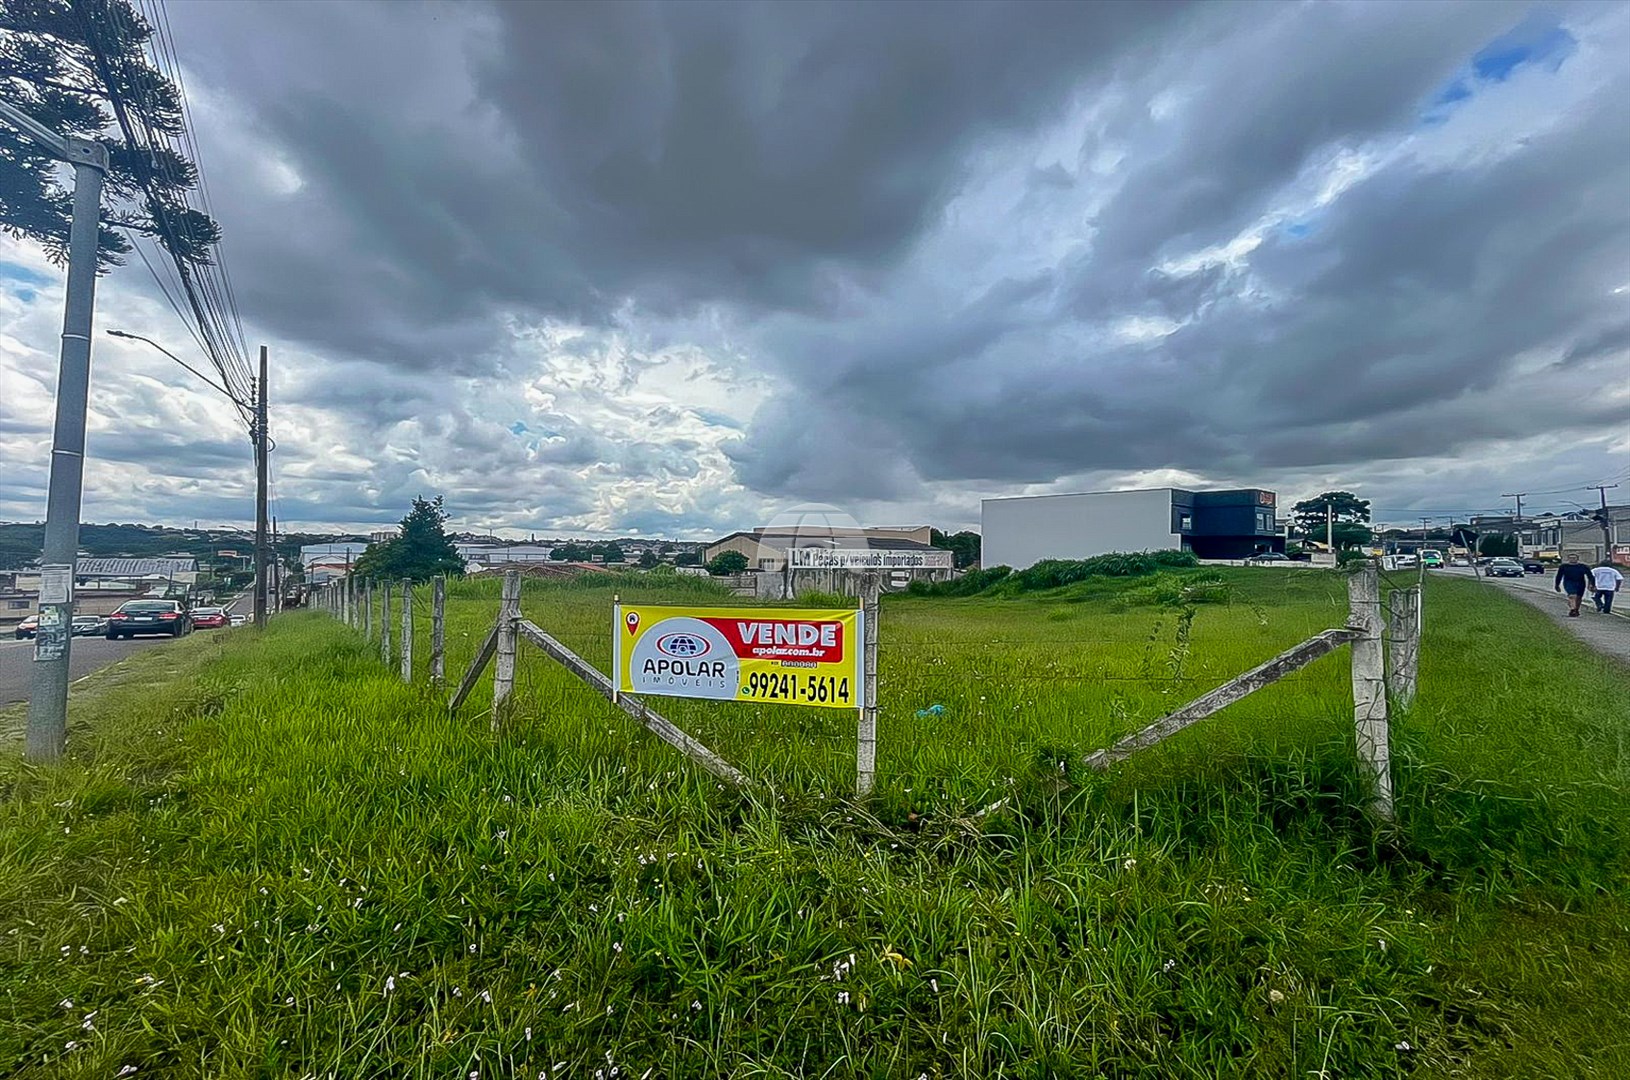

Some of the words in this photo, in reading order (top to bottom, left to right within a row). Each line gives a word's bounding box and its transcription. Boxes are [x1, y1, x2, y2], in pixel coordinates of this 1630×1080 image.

[883, 552, 923, 567] importados
[736, 622, 836, 646] VENDE
[752, 645, 825, 657] apolar.com.br
[643, 658, 726, 678] APOLAR
[749, 672, 849, 704] 99241-5614
